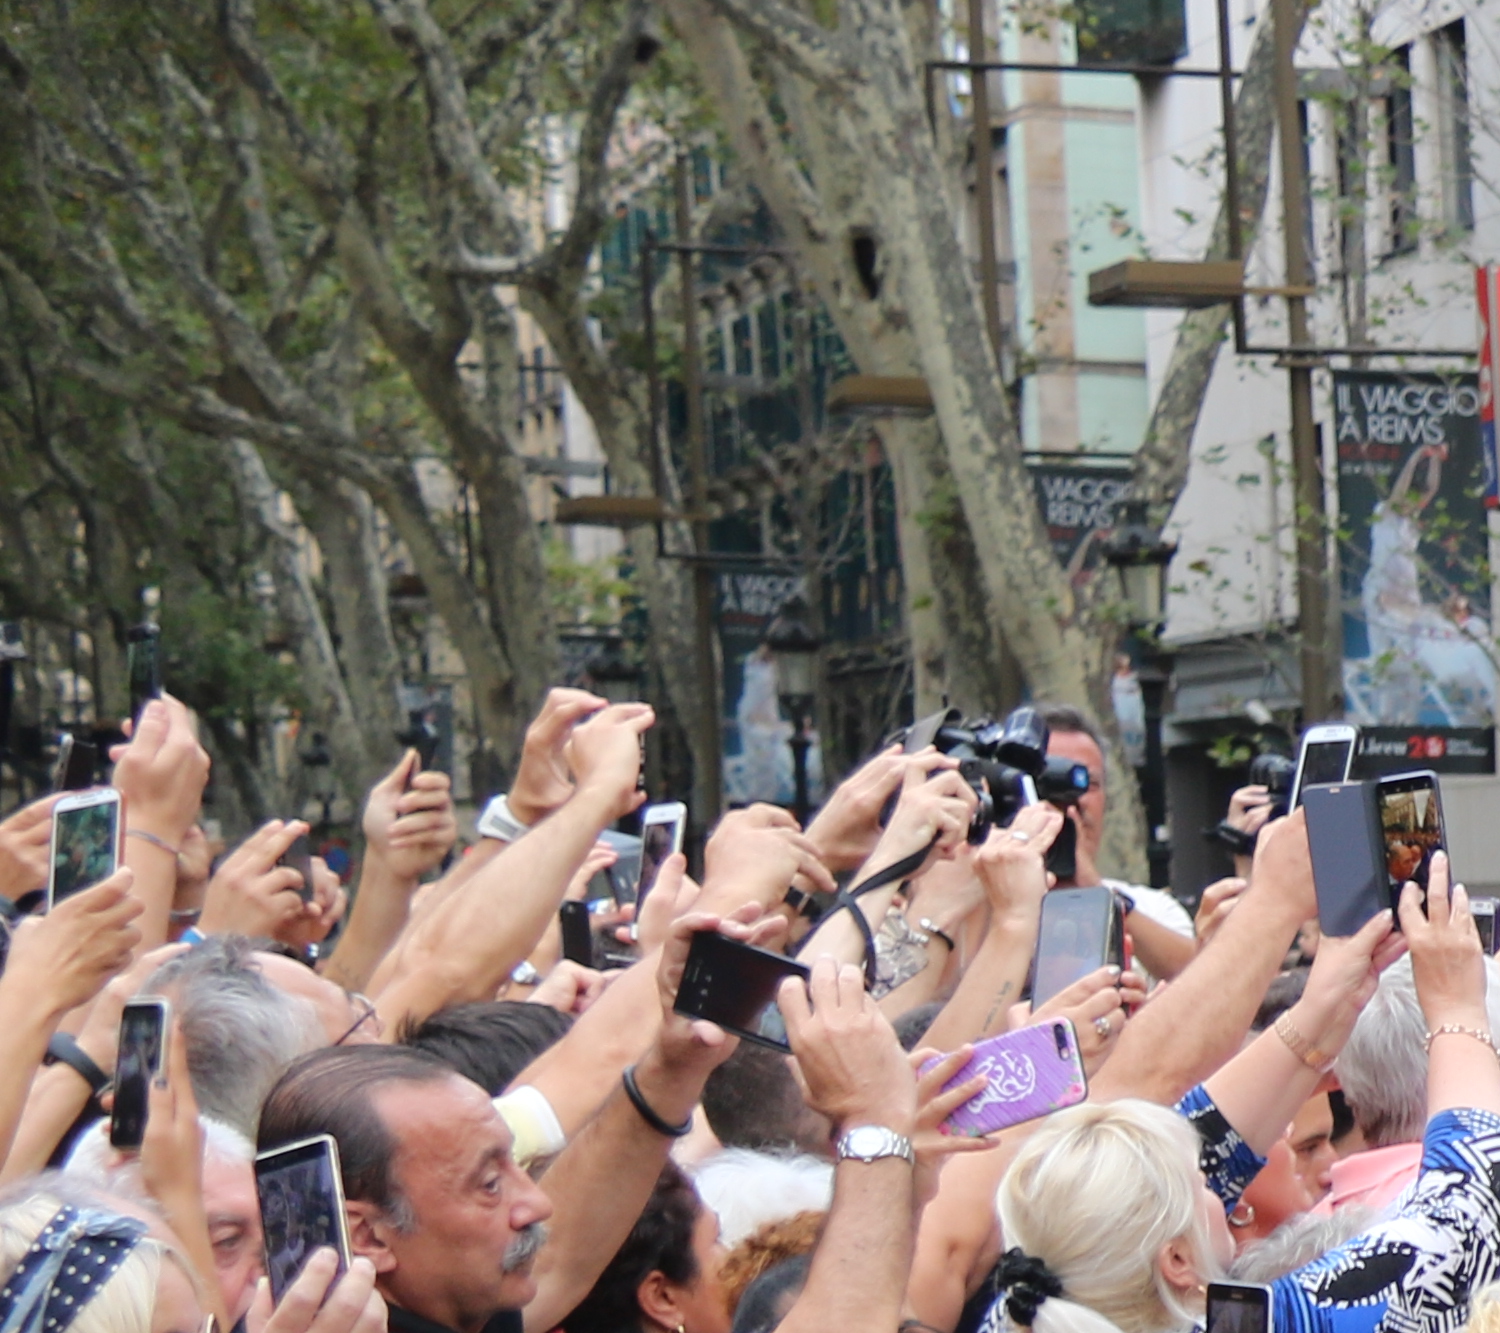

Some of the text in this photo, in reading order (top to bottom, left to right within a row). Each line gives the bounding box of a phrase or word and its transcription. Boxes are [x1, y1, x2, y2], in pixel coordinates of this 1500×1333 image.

[1337, 385, 1481, 418] IL VIAGGIO
[1338, 417, 1446, 445] A REIMS
